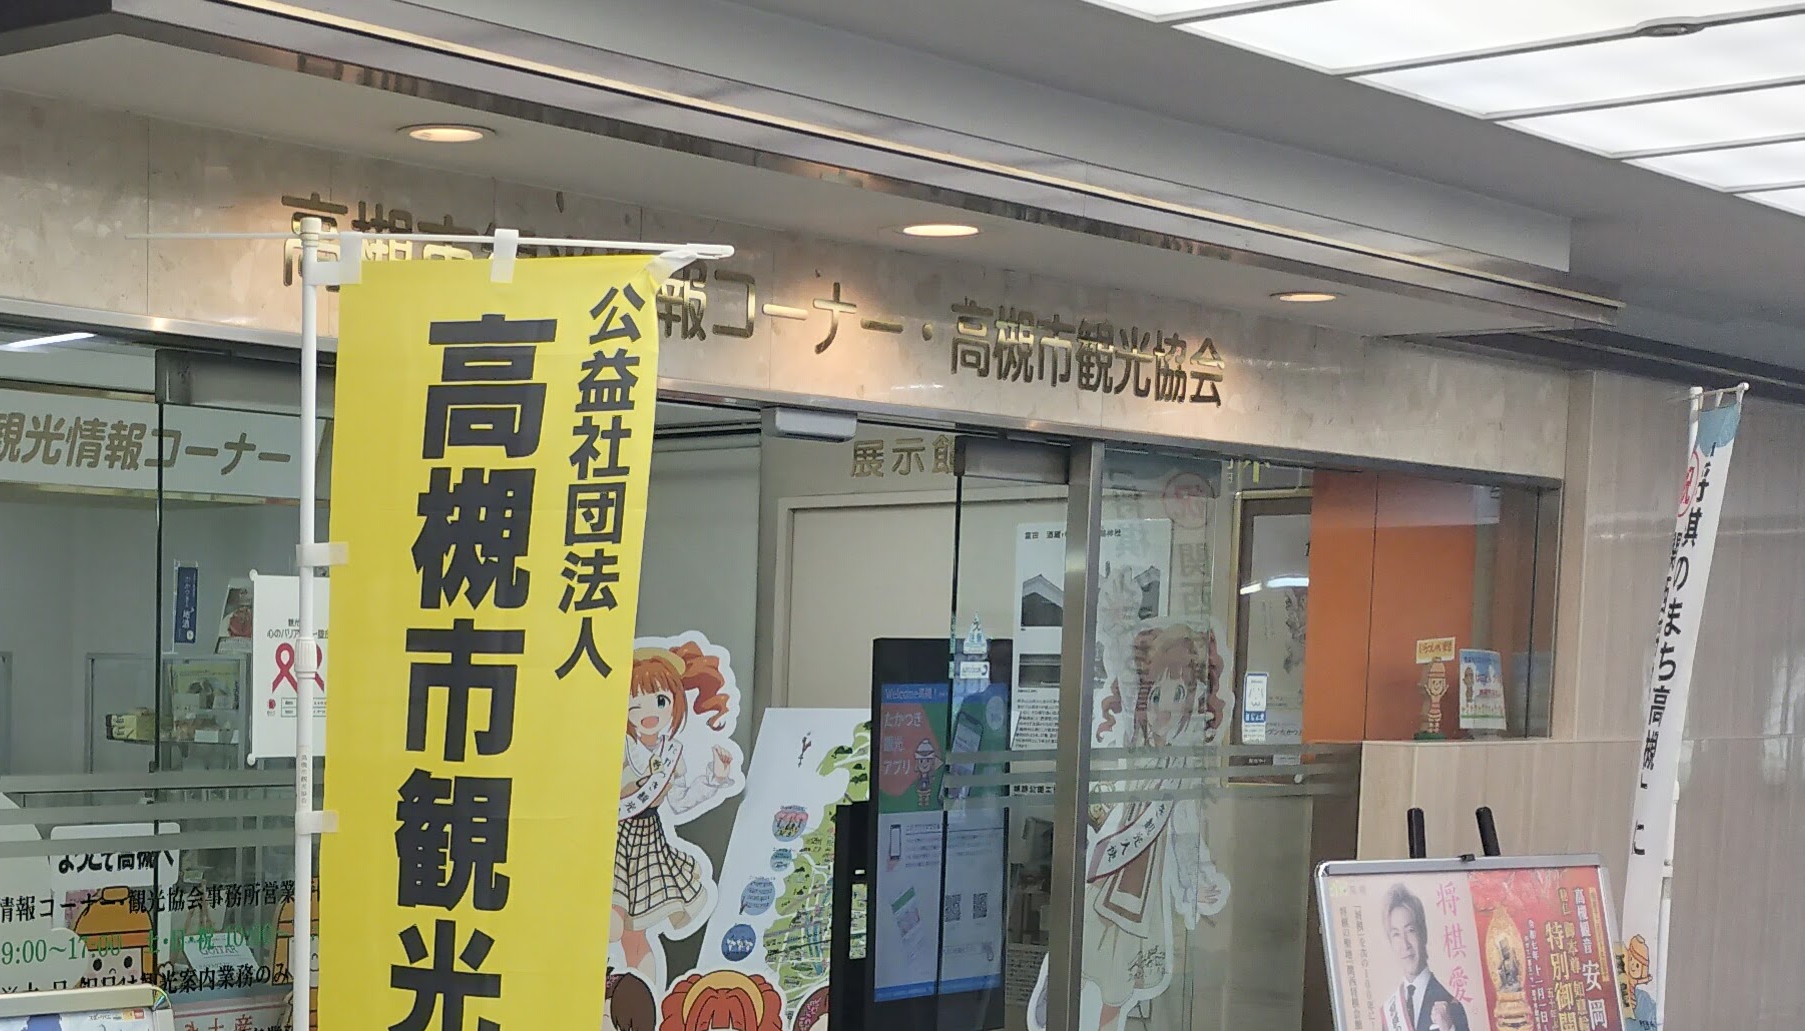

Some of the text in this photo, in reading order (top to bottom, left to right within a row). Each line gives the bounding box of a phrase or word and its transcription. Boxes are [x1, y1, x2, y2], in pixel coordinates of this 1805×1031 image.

[554, 282, 645, 680] 公益社団法人
[884, 712, 923, 728] たかつき
[883, 759, 911, 775] アプリ
[1435, 881, 1474, 1004] 将棋愛
